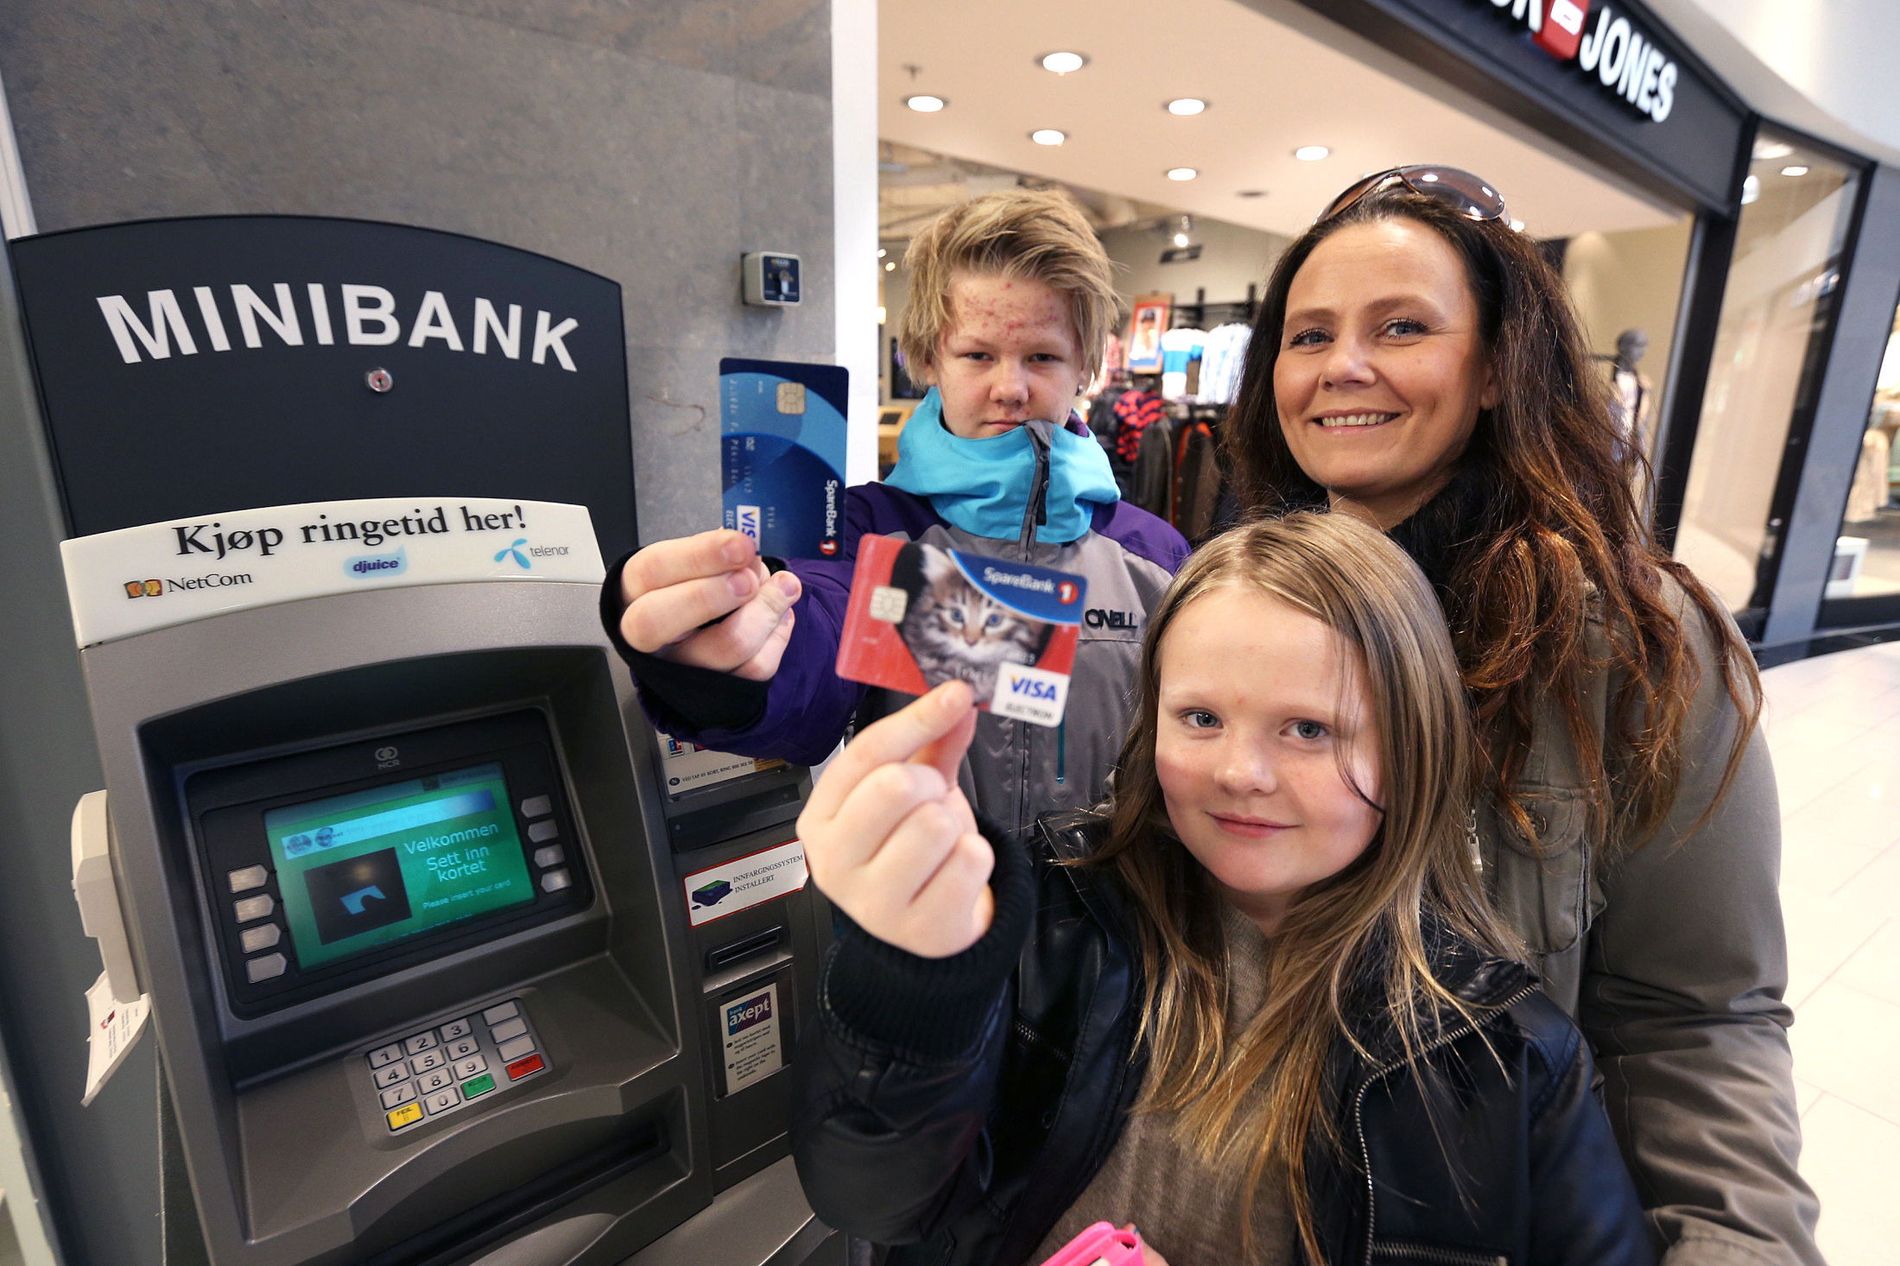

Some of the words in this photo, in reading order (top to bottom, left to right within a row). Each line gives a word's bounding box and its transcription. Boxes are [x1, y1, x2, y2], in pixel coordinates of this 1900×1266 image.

[1579, 6, 1678, 123] JONES
[97, 282, 579, 372] MINIBANK
[825, 480, 839, 537] SpareBank
[172, 522, 283, 560] Kjøp
[299, 506, 450, 546] ringetid
[459, 504, 526, 531] her!
[741, 511, 756, 540] VIS
[352, 558, 399, 573] djuice
[529, 545, 569, 558] telenor
[167, 572, 253, 593] NetCom
[983, 566, 1055, 594] SpareBank
[1011, 674, 1057, 702] VISA
[404, 823, 499, 855] Velkommen
[426, 852, 461, 871] Sett
[464, 846, 490, 861] inn
[436, 860, 487, 882] kortet
[733, 854, 803, 883] INNFARGINGSSYSTEM
[734, 874, 775, 893] INSTALLERT
[729, 997, 770, 1026] axept
[380, 1052, 390, 1061] 1
[415, 1038, 428, 1049] 2
[451, 1025, 462, 1036] 3
[388, 1068, 399, 1080] 4
[424, 1055, 435, 1067] 5
[458, 1042, 469, 1053] 6
[393, 1088, 404, 1102] 7
[431, 1075, 442, 1087] 8
[466, 1061, 476, 1073] 9
